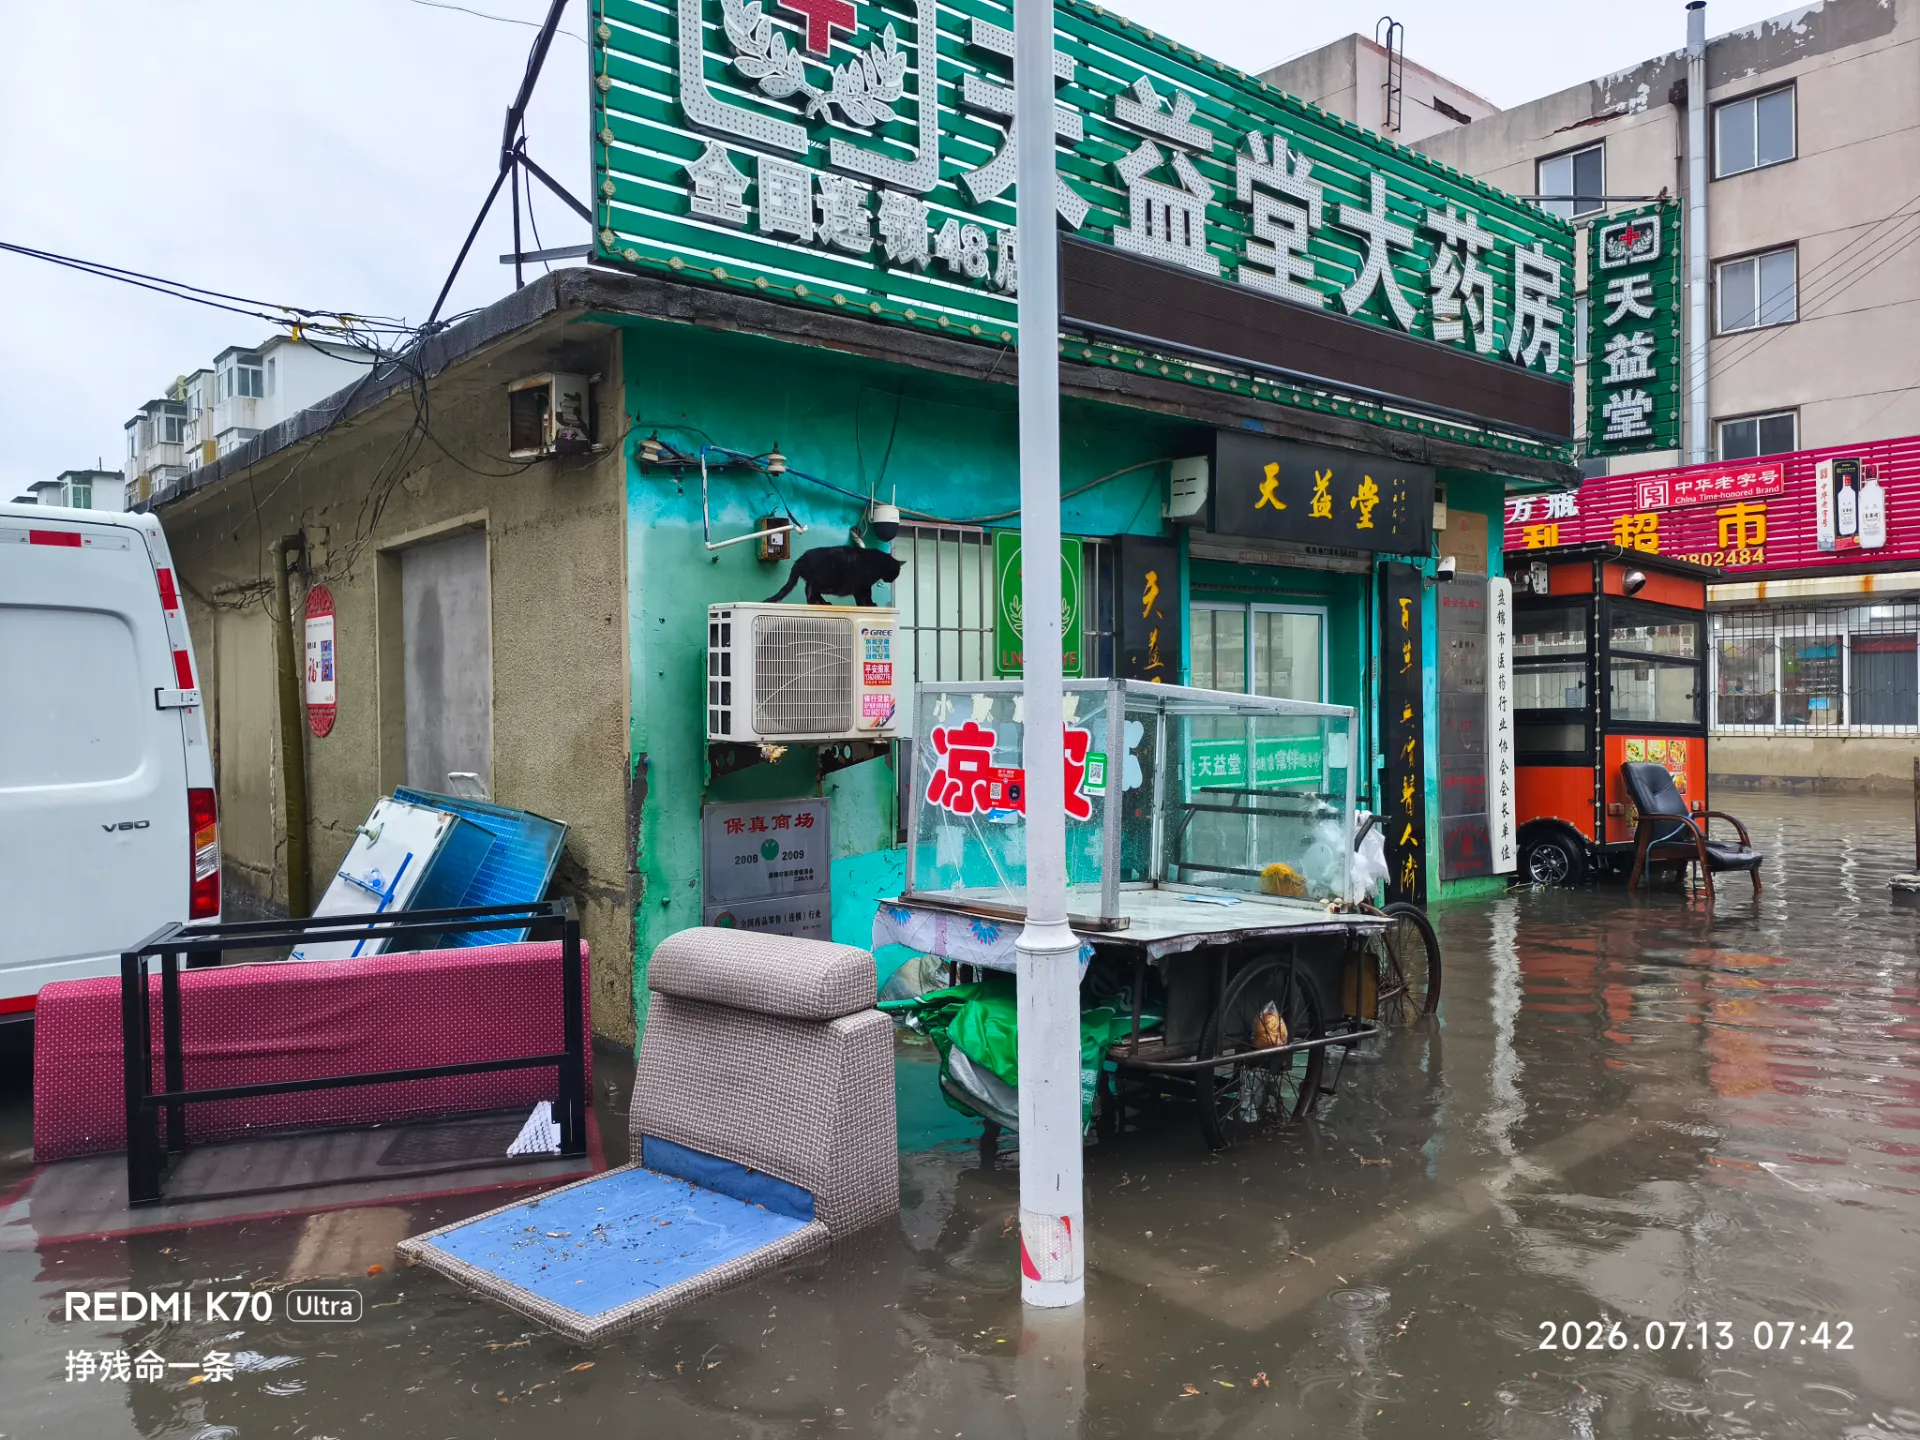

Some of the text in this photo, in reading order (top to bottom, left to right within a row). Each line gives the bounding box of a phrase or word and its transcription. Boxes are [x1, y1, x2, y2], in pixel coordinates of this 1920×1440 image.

[958, 15, 1563, 375] 天益堂大药房
[1602, 273, 1657, 441] 天益堂
[1675, 470, 1779, 494] 中华老字号
[1254, 461, 1380, 530] 天益堂
[1675, 485, 1779, 505] China Time-honored Brand
[869, 629, 893, 637] GREE
[1002, 650, 1077, 668] LNYF
[723, 812, 815, 835] 保真商场
[734, 849, 805, 866] 2008 2009
